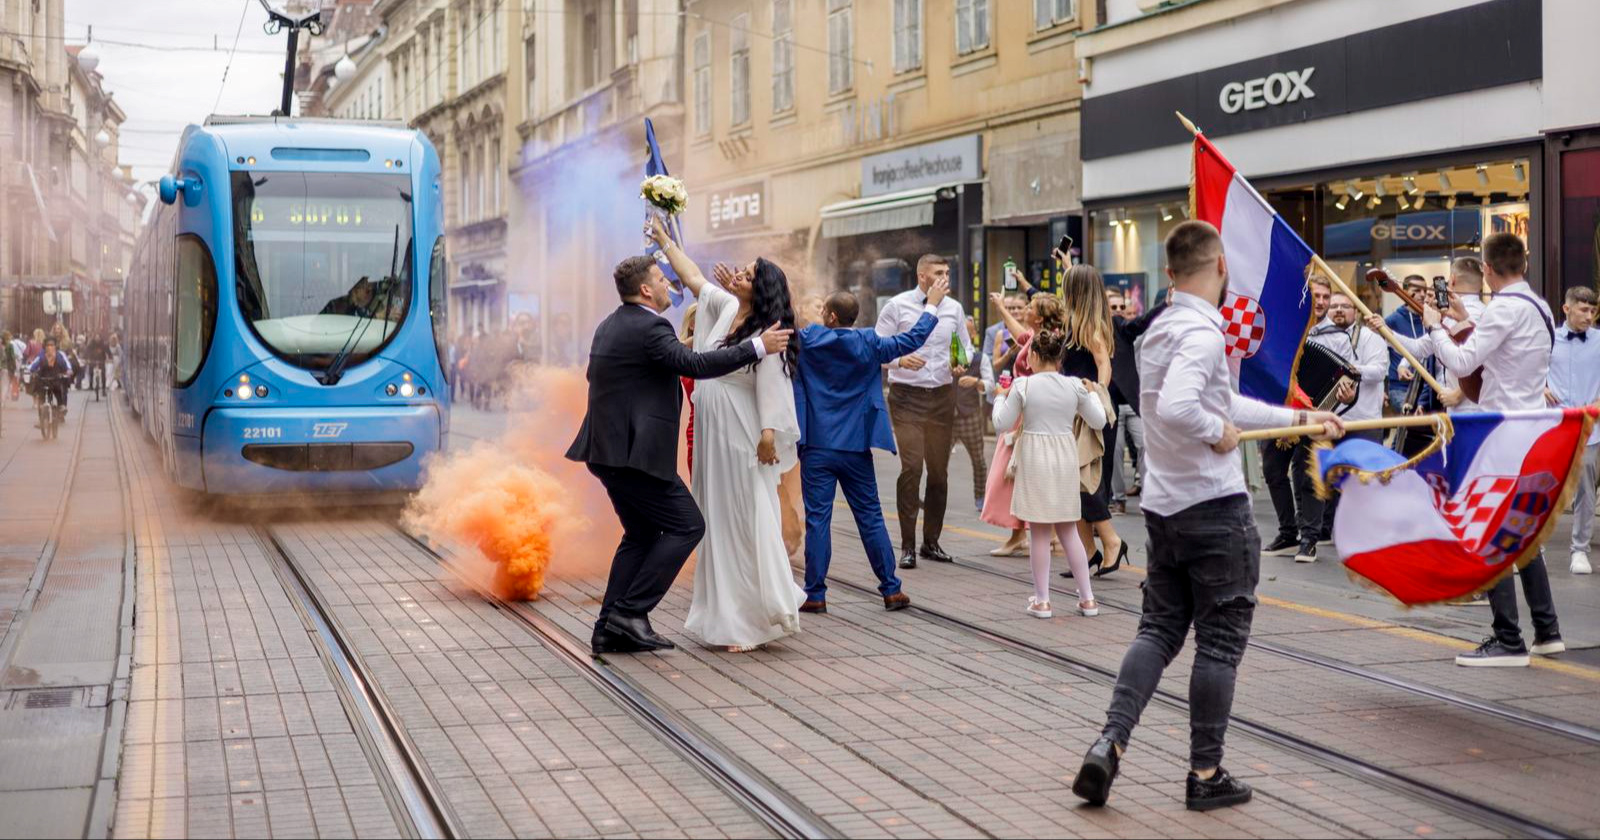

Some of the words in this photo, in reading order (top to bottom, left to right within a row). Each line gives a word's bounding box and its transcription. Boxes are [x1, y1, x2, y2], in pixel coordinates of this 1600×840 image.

[1218, 66, 1315, 114] GEOX
[1370, 224, 1446, 240] GEOX
[243, 427, 282, 438] 22101
